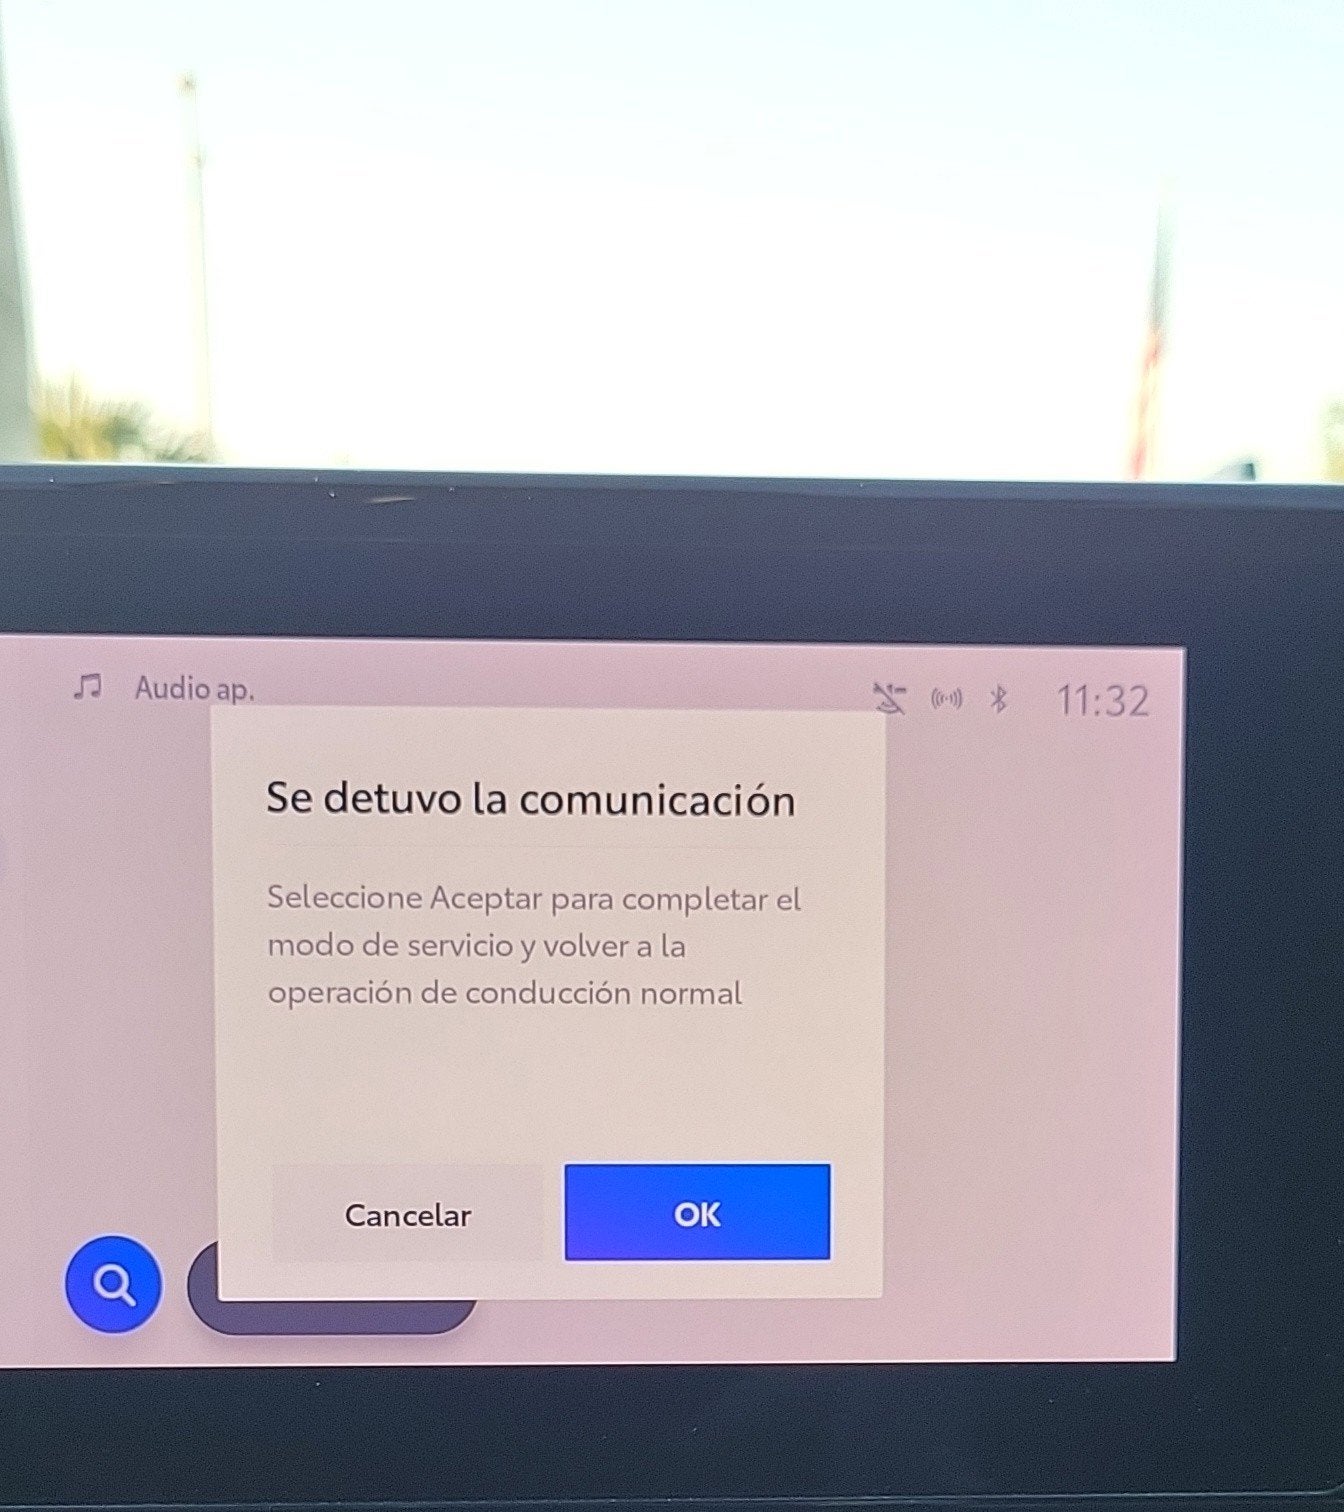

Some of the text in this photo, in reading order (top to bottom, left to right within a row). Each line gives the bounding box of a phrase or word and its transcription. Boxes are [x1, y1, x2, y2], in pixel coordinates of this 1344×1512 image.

[135, 674, 255, 706] Audio ap.
[1057, 683, 1150, 717] 11:32
[266, 779, 797, 818] Se detuvo la comunicación
[267, 884, 802, 918] Seleccione Aceptar para completar el
[268, 931, 687, 964] modo de servicio y volver a la
[268, 979, 744, 1010] operación de conducción normal
[345, 1202, 472, 1228] Cancelar
[673, 1201, 722, 1228] OK
